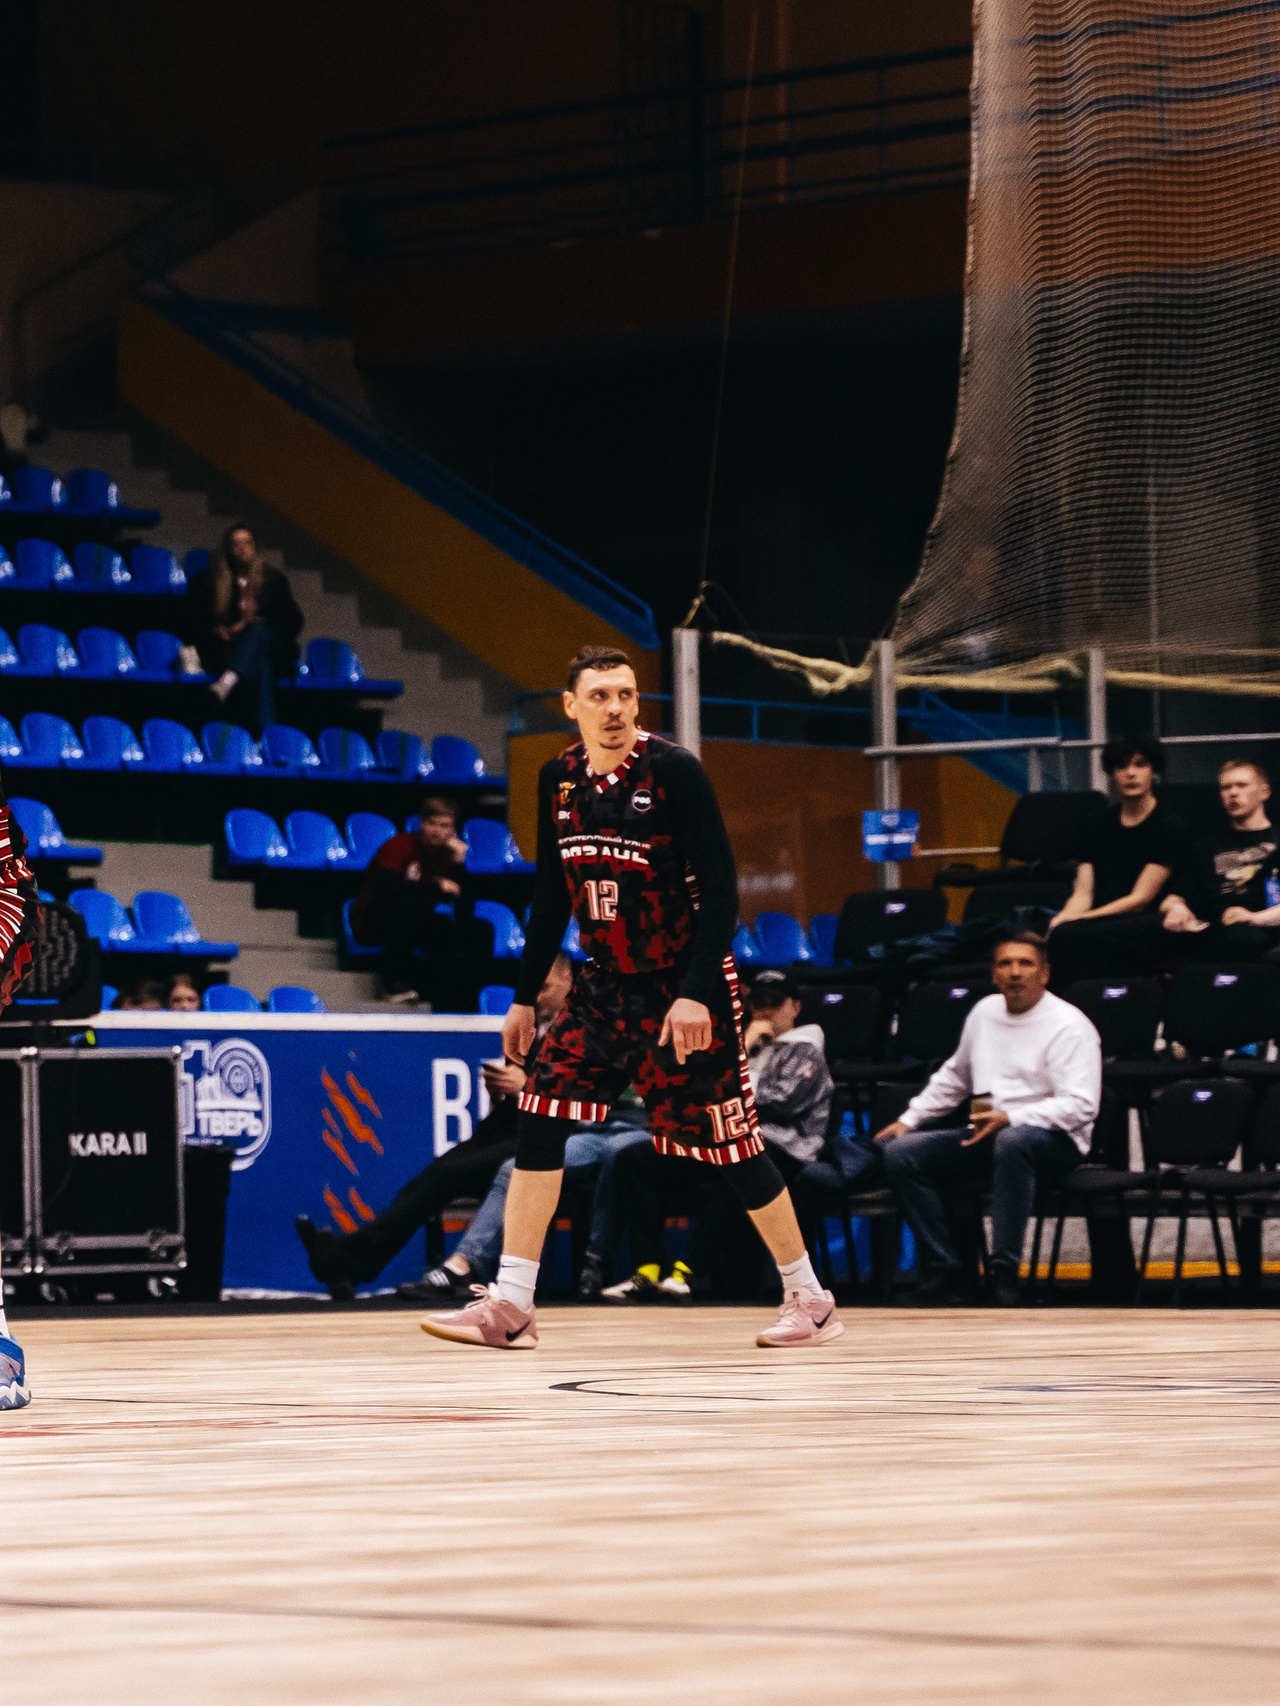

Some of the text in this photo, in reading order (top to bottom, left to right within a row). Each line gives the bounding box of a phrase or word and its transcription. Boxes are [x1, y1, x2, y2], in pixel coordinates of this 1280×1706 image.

[584, 879, 619, 921] 12
[196, 1111, 264, 1137] ТВЕРЬ
[706, 1096, 750, 1144] 12
[67, 1131, 132, 1157] KARA
